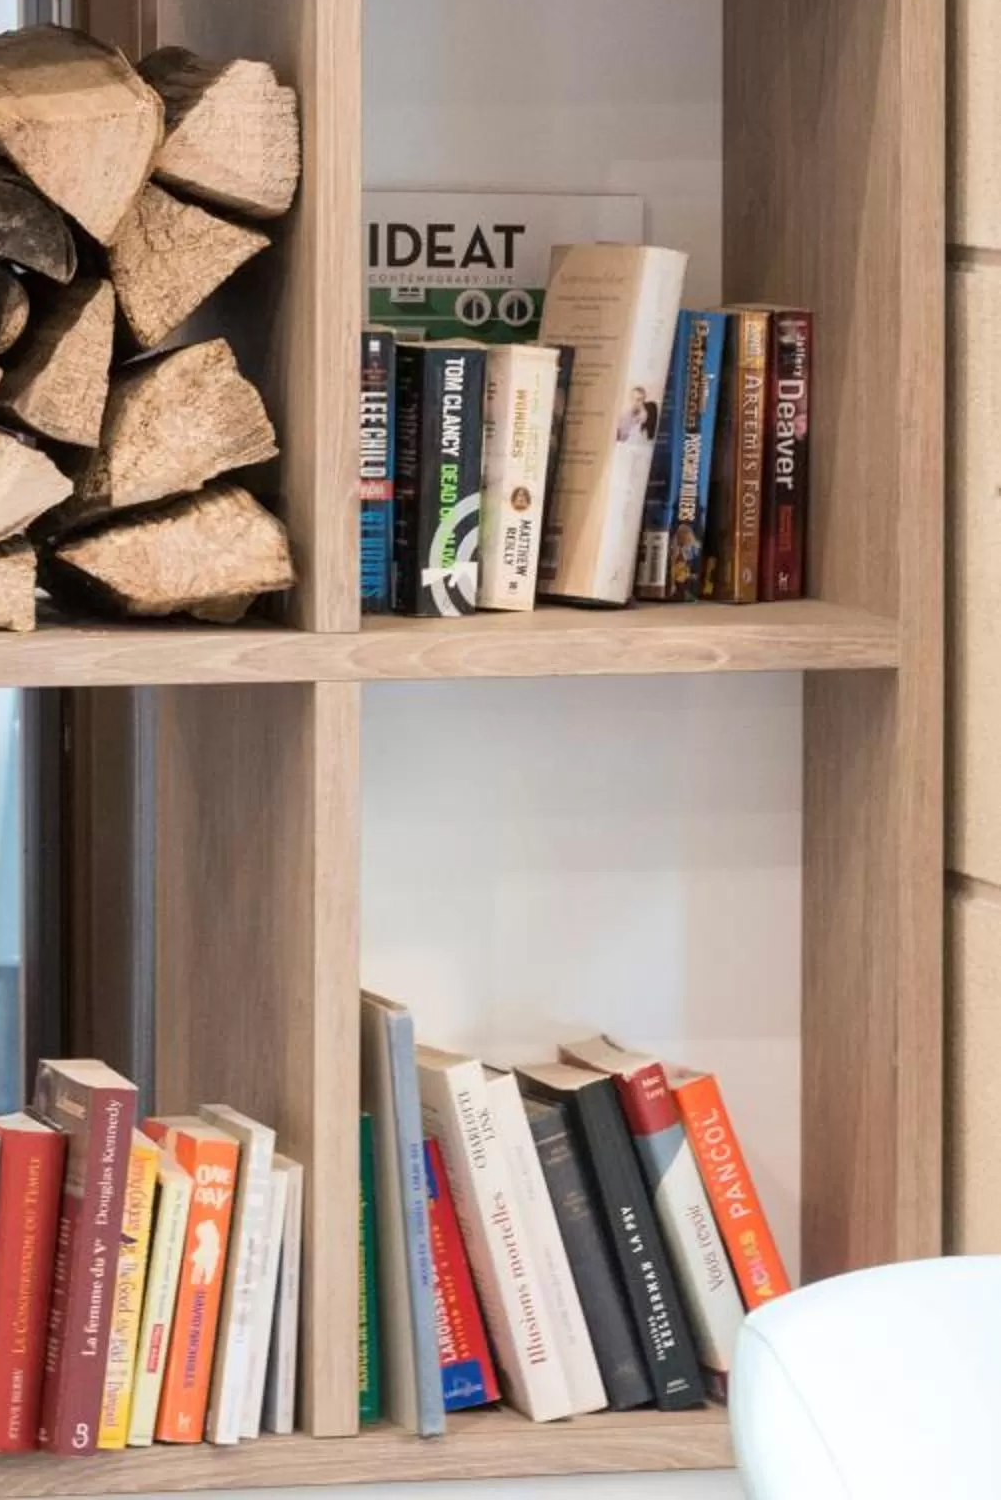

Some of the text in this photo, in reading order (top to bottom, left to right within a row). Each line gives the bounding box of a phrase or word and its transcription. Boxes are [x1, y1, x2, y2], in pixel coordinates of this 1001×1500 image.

[369, 222, 525, 269] IDEAT
[487, 274, 515, 286] LIFE
[444, 356, 464, 391] TOM
[360, 391, 387, 422] LEE
[440, 393, 463, 456] CLANCY
[359, 427, 387, 477] CHILD
[772, 378, 804, 489] Deaver
[438, 463, 458, 502] DEAD
[502, 526, 517, 566] REILLY
[515, 519, 532, 576] MATTHEW
[99, 1098, 122, 1163] Kennedy
[195, 1163, 231, 1188] ONE
[691, 1106, 755, 1220] PANCOL
[93, 1166, 116, 1225] Douglas
[194, 1184, 233, 1211] DAY
[627, 1233, 644, 1253] LA
[733, 1228, 777, 1299] ACHAS
[88, 1256, 105, 1278] du
[485, 1189, 550, 1366] Illusions mortelles
[699, 1250, 726, 1292] Vous
[82, 1279, 103, 1333] femme
[640, 1259, 676, 1348] KELLERMAN
[80, 1334, 98, 1357] La
